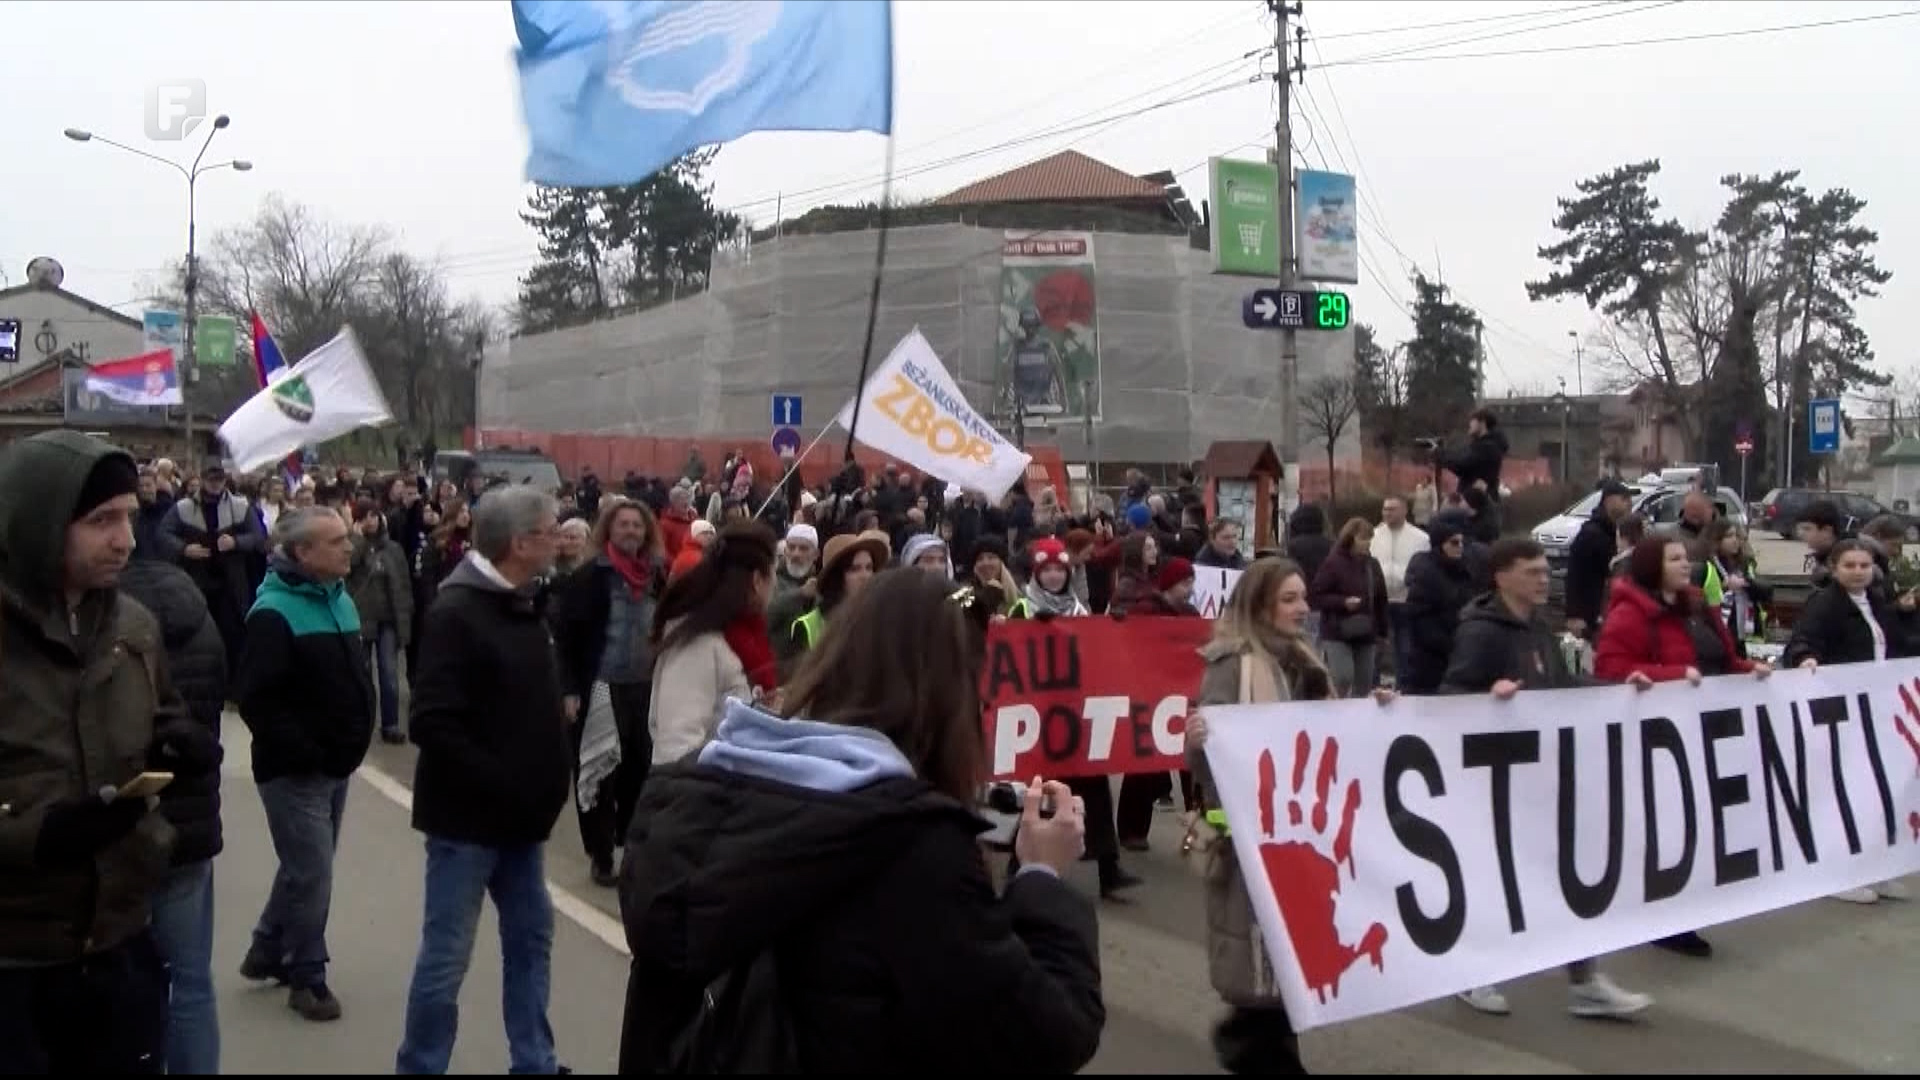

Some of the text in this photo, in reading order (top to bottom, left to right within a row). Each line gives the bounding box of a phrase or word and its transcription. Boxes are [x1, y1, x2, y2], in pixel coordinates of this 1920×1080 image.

[1319, 294, 1346, 326] 29
[872, 374, 992, 464] ZBOR
[988, 635, 1081, 697] АШ
[990, 694, 1192, 776] РОТЕС
[1382, 691, 1897, 956] STUDENTI
